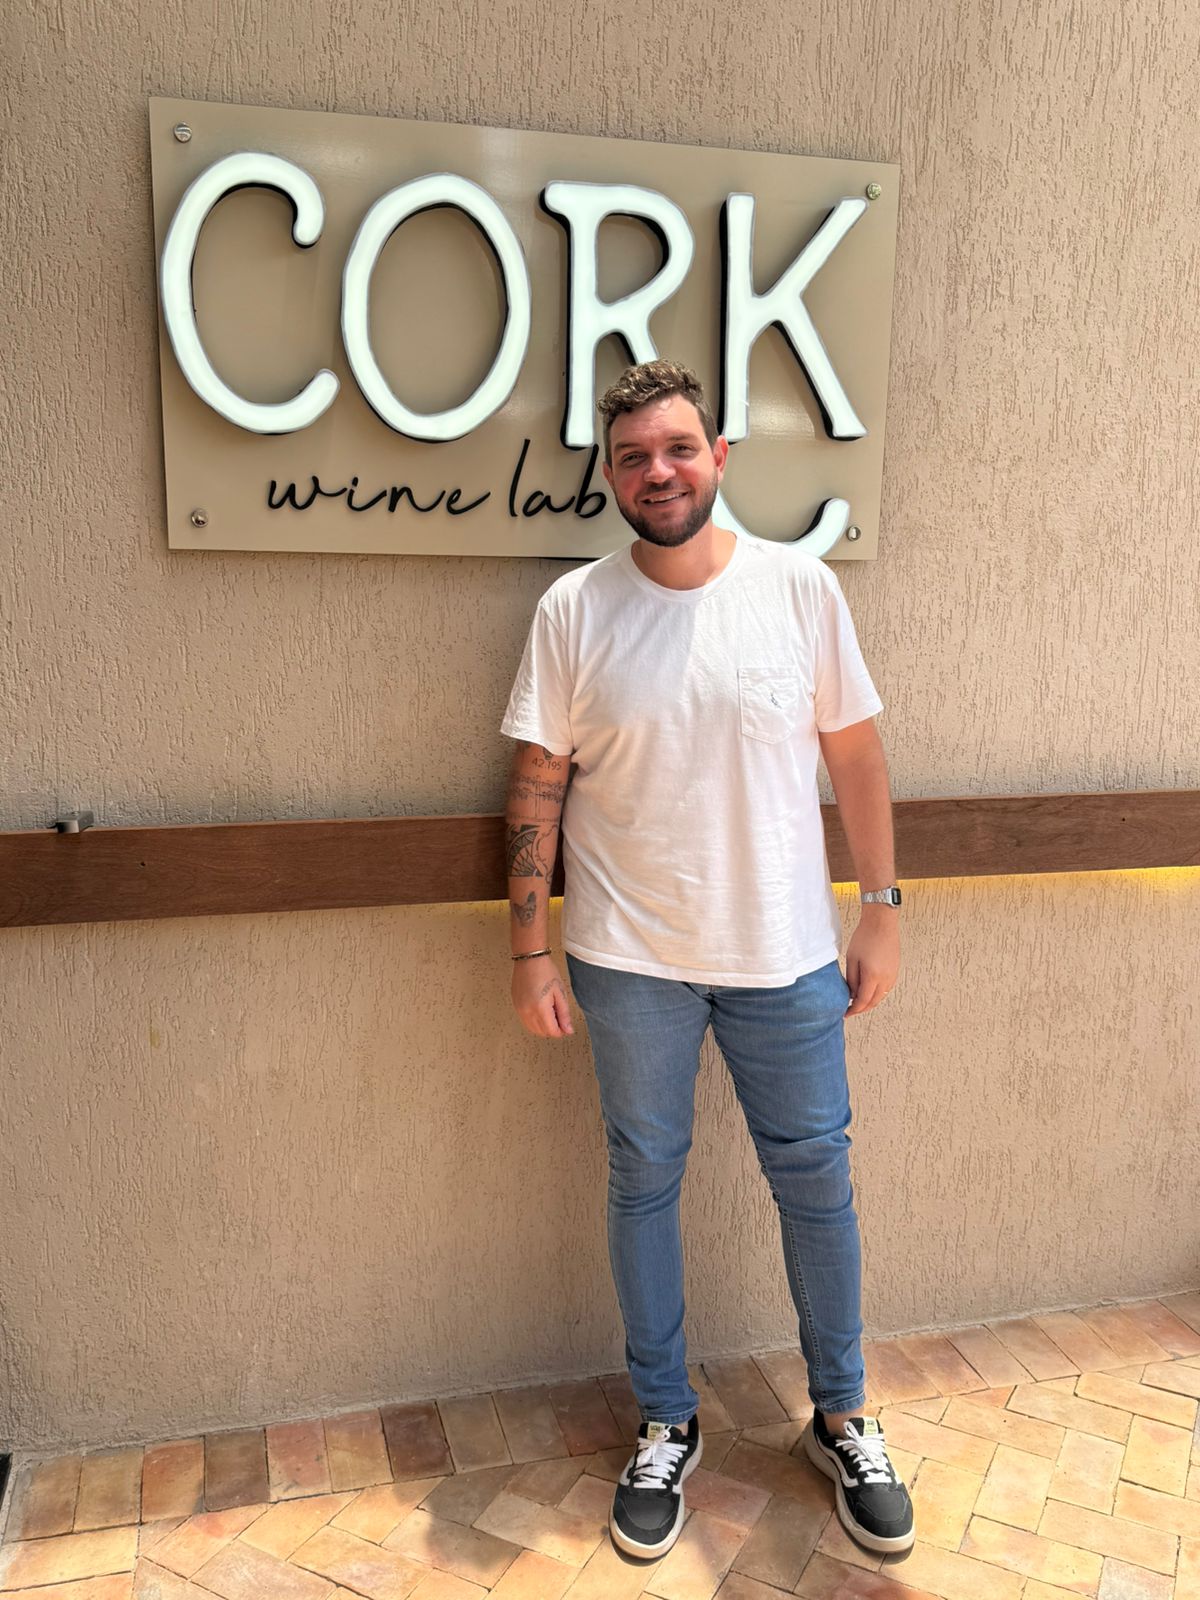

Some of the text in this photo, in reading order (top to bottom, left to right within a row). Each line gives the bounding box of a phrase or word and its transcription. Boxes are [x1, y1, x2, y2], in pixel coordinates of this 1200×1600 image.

[160, 151, 869, 558] CORK
[267, 438, 607, 518] wine lab
